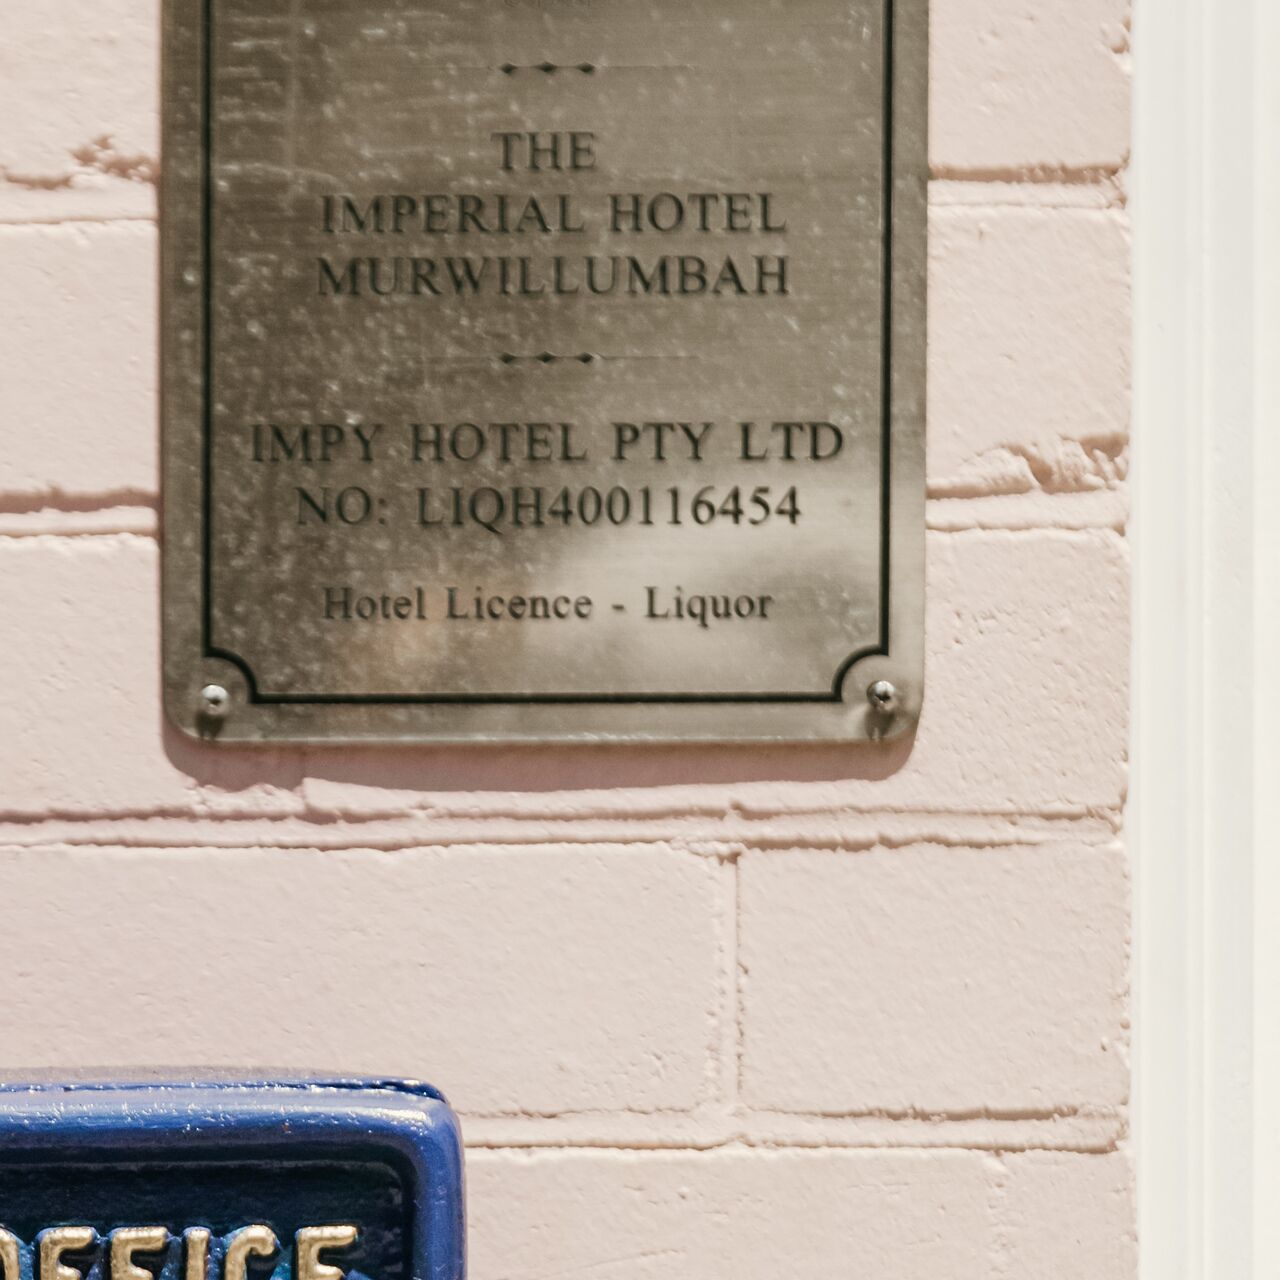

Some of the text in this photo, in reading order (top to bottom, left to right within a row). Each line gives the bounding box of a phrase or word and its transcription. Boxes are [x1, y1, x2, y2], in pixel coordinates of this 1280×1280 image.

[491, 131, 598, 171] THE
[320, 192, 788, 235] IMPERIAL HOTEL
[317, 255, 790, 297] MURWILLUMBAH
[250, 421, 846, 464] IMPY HOTEL PTY LTD
[295, 485, 802, 535] NO: LIQH400116454
[320, 586, 427, 622] Hotel
[446, 586, 593, 621] Licence
[645, 585, 774, 627] Liquor
